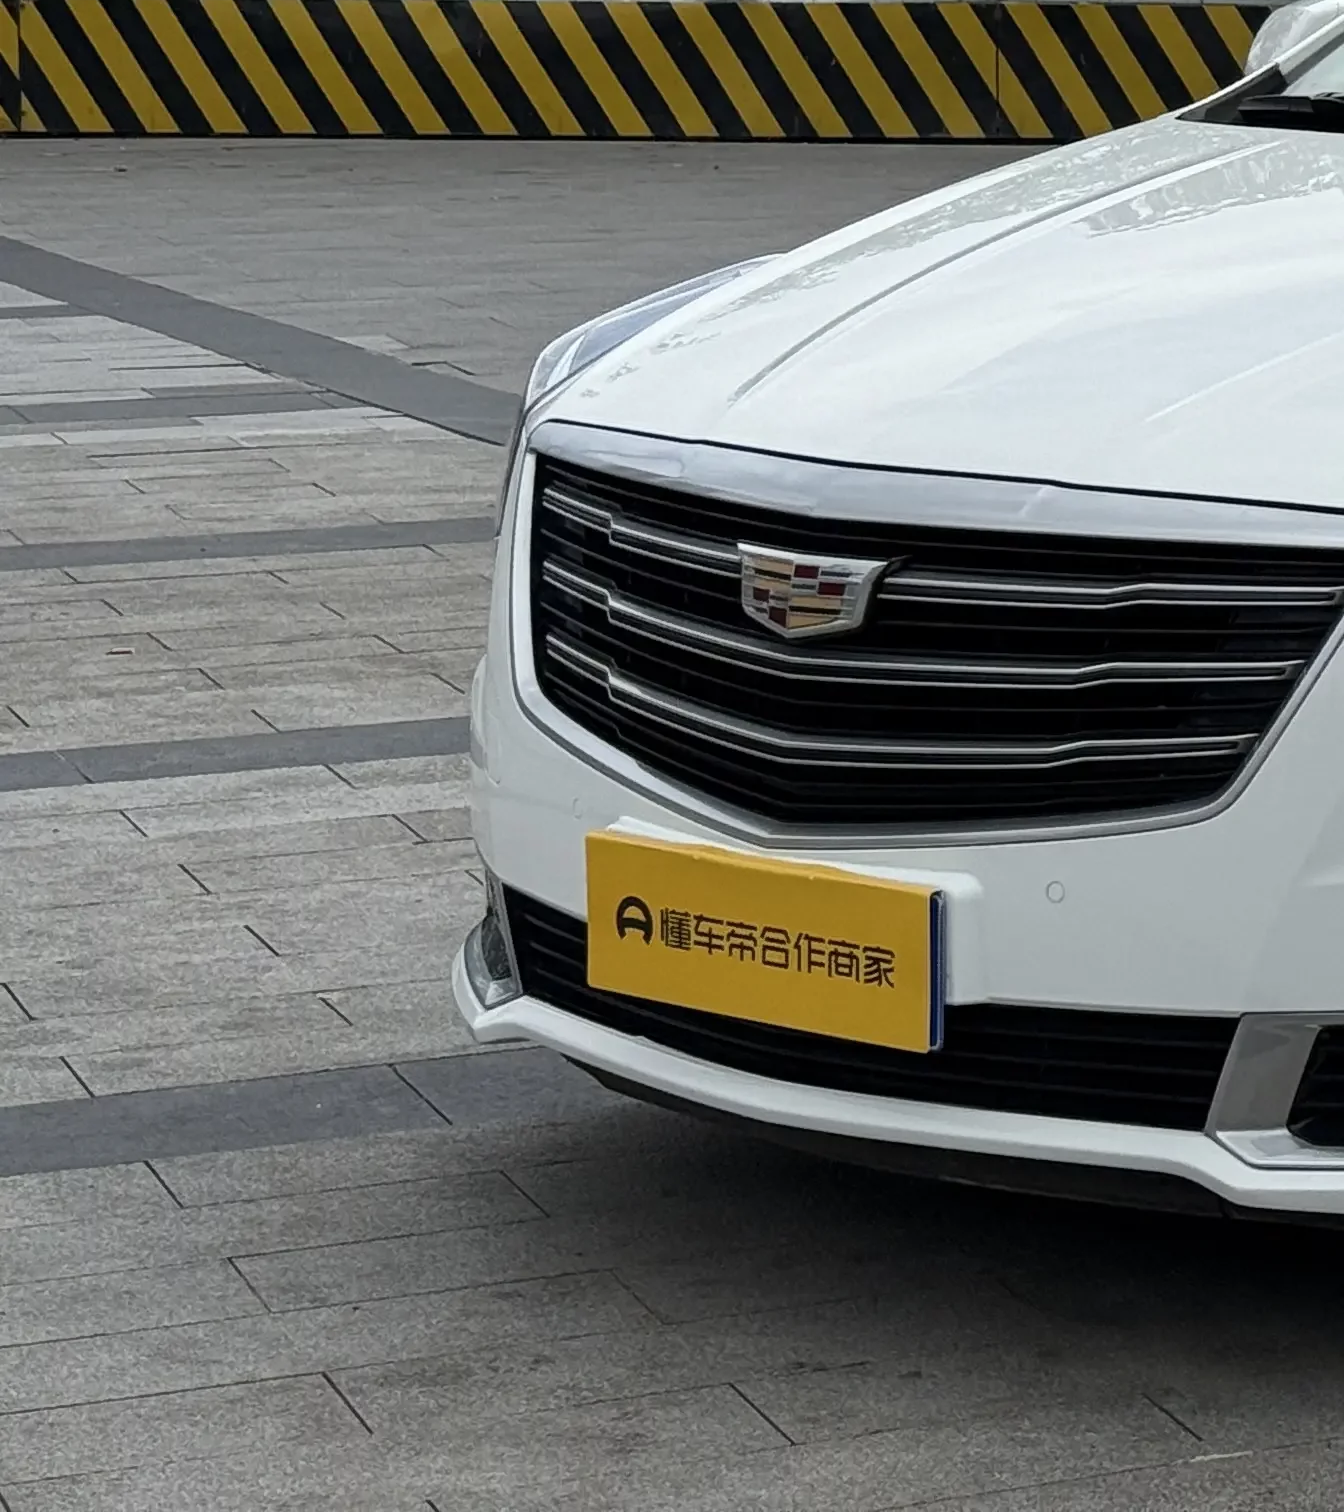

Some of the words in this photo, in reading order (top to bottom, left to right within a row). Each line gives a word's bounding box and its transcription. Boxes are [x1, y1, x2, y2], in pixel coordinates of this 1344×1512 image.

[660, 907, 896, 989] 懂车帝合作商家
